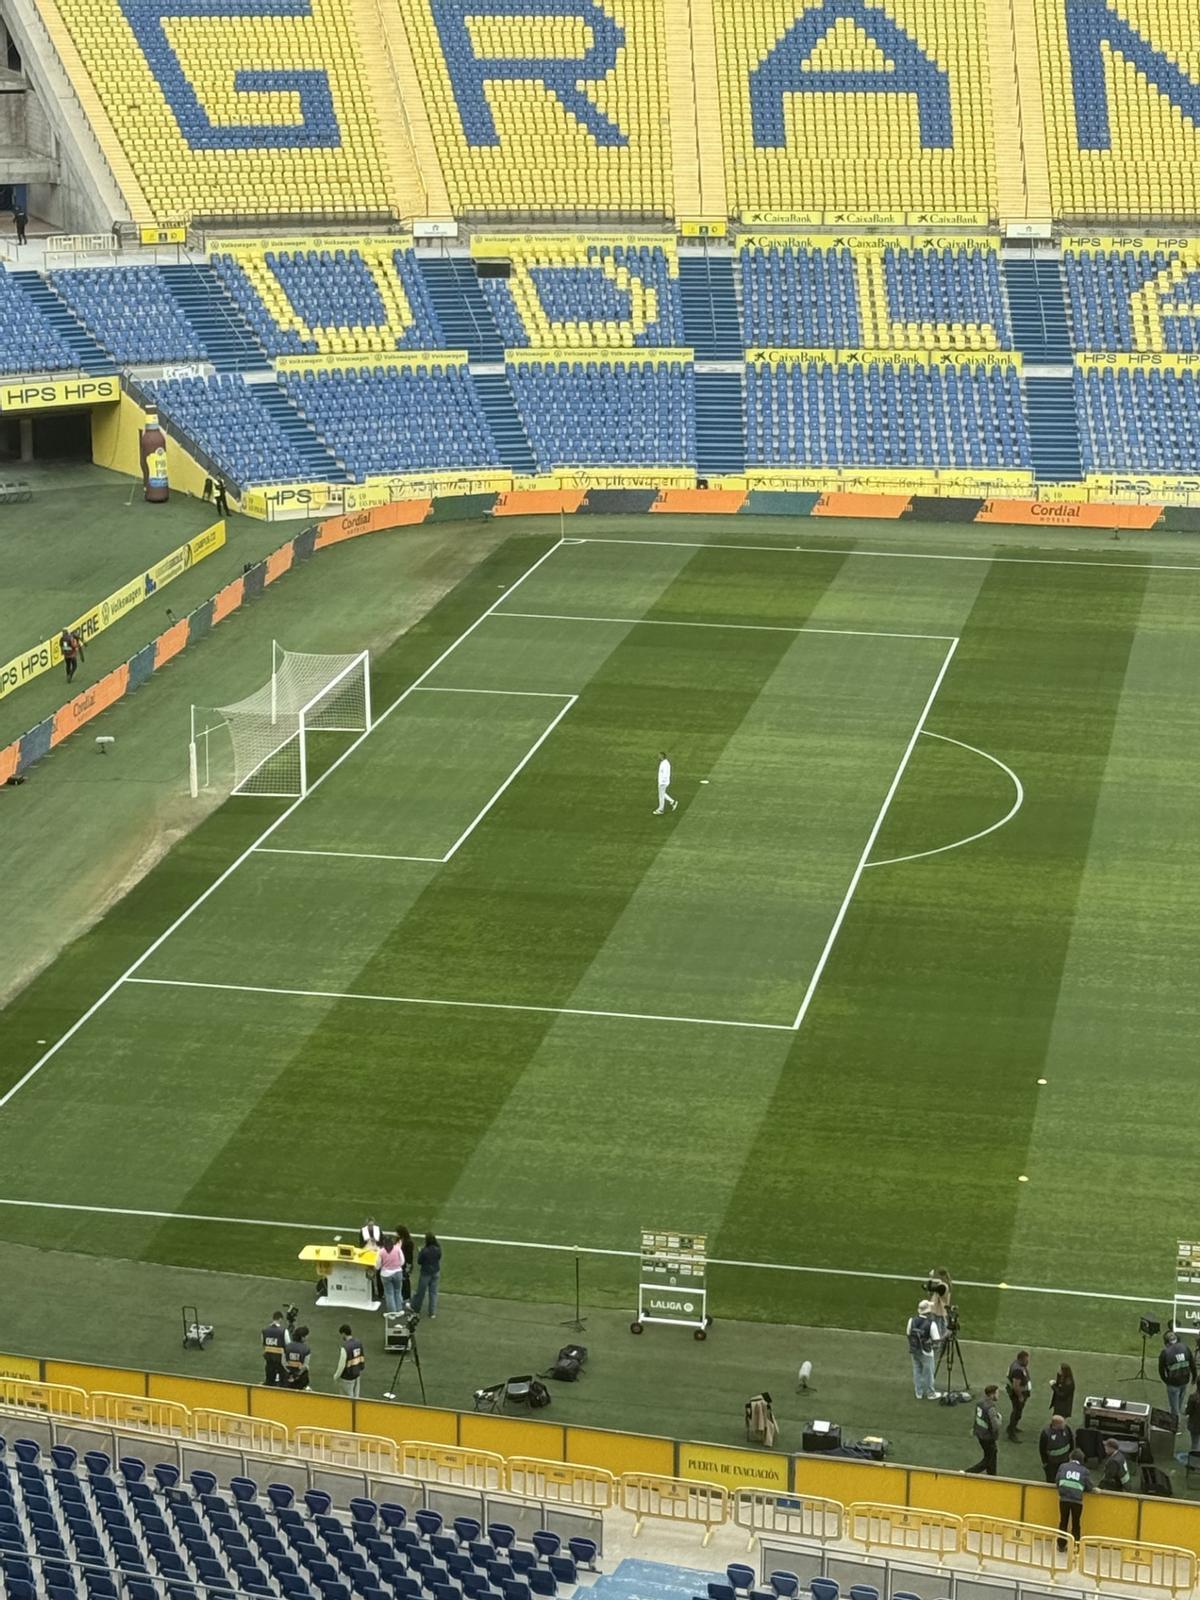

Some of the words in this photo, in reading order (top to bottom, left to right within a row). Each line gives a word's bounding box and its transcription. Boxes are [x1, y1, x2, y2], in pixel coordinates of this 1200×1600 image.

[763, 213, 812, 223] CaixaBank
[846, 213, 895, 224] CaixaBank
[929, 214, 979, 224] CaixaBank
[757, 237, 813, 248] CaixaBank
[847, 237, 903, 249] CaixaBank
[936, 238, 992, 250] CaixaBank
[1070, 238, 1101, 247] HPS
[1112, 238, 1143, 248] HPS
[1156, 239, 1188, 248] HPS
[768, 352, 827, 364] CaixaBank
[861, 352, 920, 365] CaixaBank
[955, 353, 1013, 366] CaixaBank
[1083, 354, 1117, 363] HPS
[1128, 354, 1162, 364] HPS
[1176, 355, 1200, 364] HP
[7, 387, 57, 405] HPS
[64, 382, 113, 399] HPS
[264, 488, 312, 505] HPS
[1030, 503, 1080, 518] Cordial
[341, 512, 371, 530] Cordial
[110, 587, 142, 615] Volkswagen
[21, 649, 49, 679] HPS
[650, 1299, 682, 1311] LALIGA
[1185, 1310, 1200, 1320] LAL
[688, 1459, 719, 1473] PUERTA
[720, 1463, 734, 1474] DE
[733, 1465, 780, 1481] EVACUACIÓN
